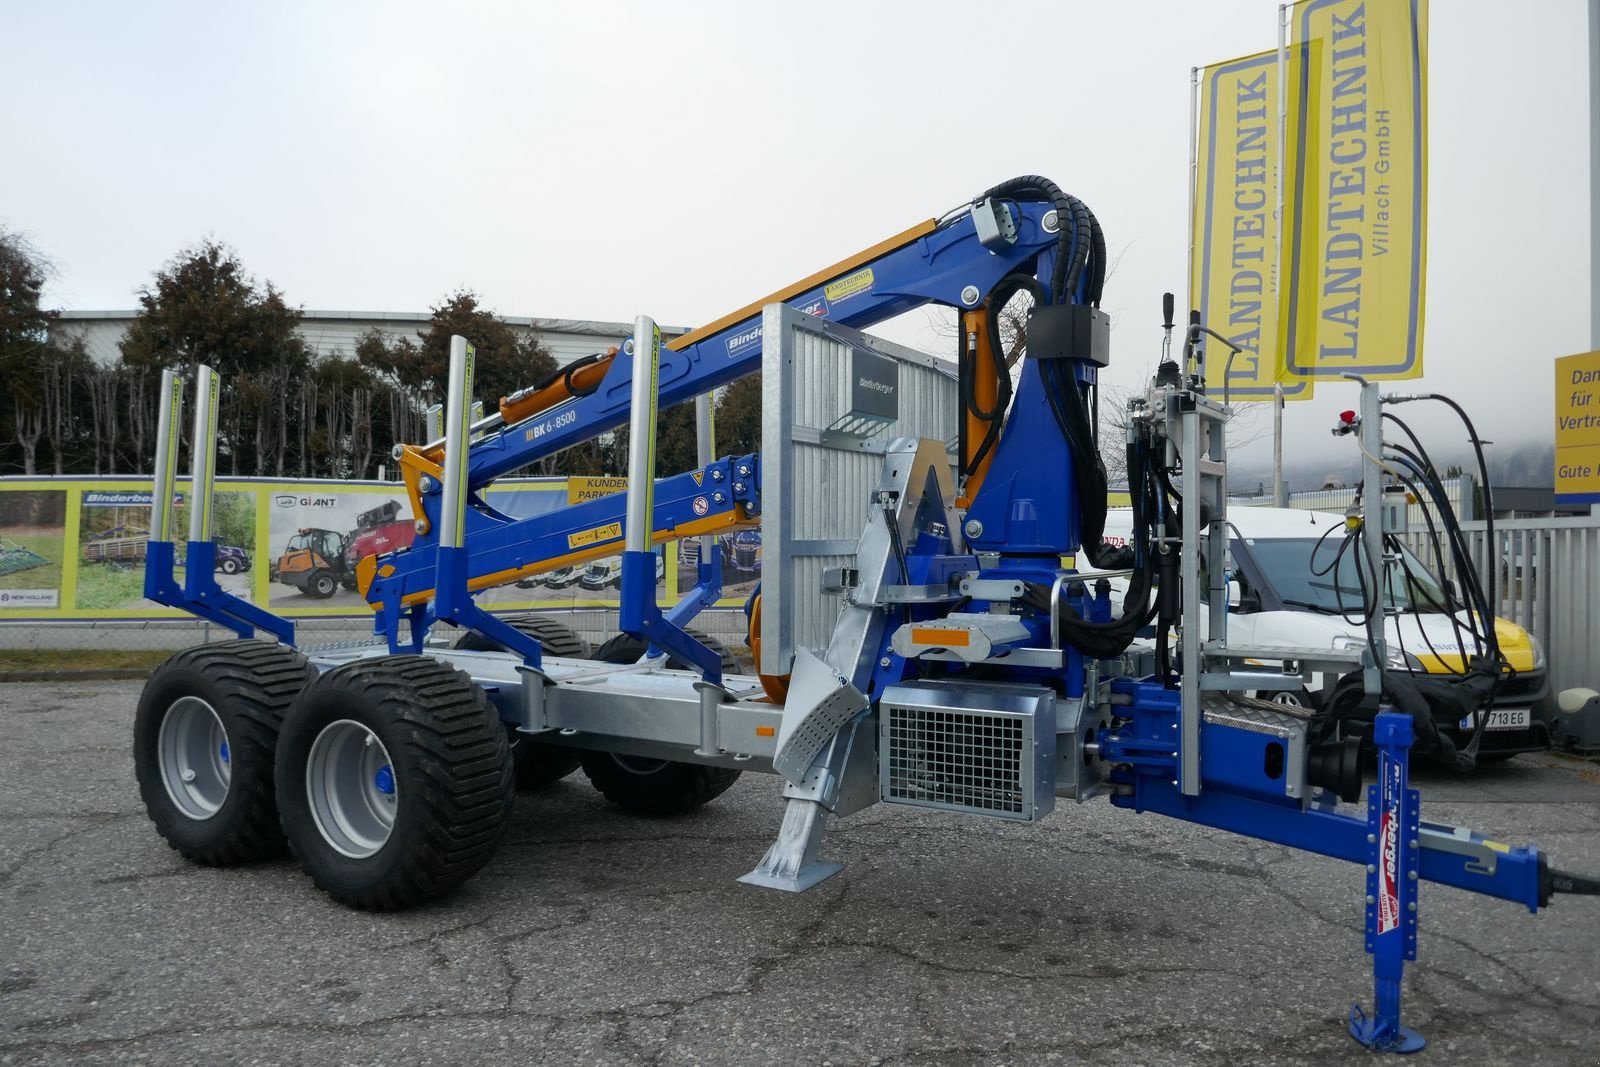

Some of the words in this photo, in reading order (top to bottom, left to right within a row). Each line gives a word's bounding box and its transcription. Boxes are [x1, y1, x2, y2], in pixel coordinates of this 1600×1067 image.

[1374, 110, 1390, 174] GmbH
[1319, 2, 1367, 360] LANDTECHNIK
[1228, 70, 1266, 381] LANDTECHNIK
[1372, 184, 1390, 257] Villach
[1570, 390, 1592, 407] für
[533, 423, 545, 438] BK
[1558, 464, 1591, 479] Gute
[1511, 712, 1524, 725] EG
[1381, 893, 1389, 922] AUSTRIA
